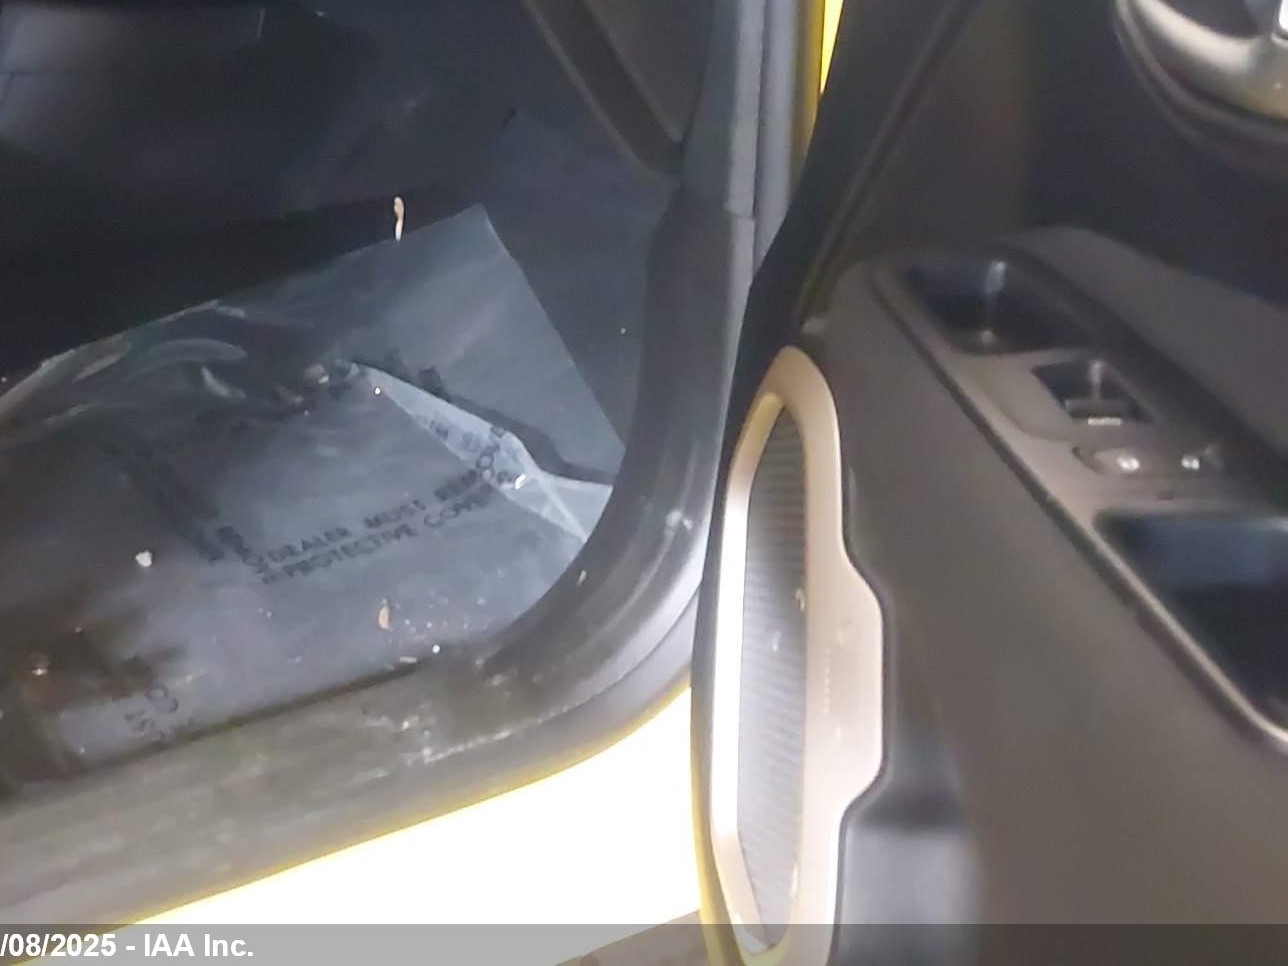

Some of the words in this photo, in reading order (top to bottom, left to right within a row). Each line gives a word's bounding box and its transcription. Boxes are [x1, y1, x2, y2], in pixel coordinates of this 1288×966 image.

[267, 527, 353, 564] DEALER
[363, 499, 426, 528] MUST
[283, 523, 416, 578] PROTECTIVE
